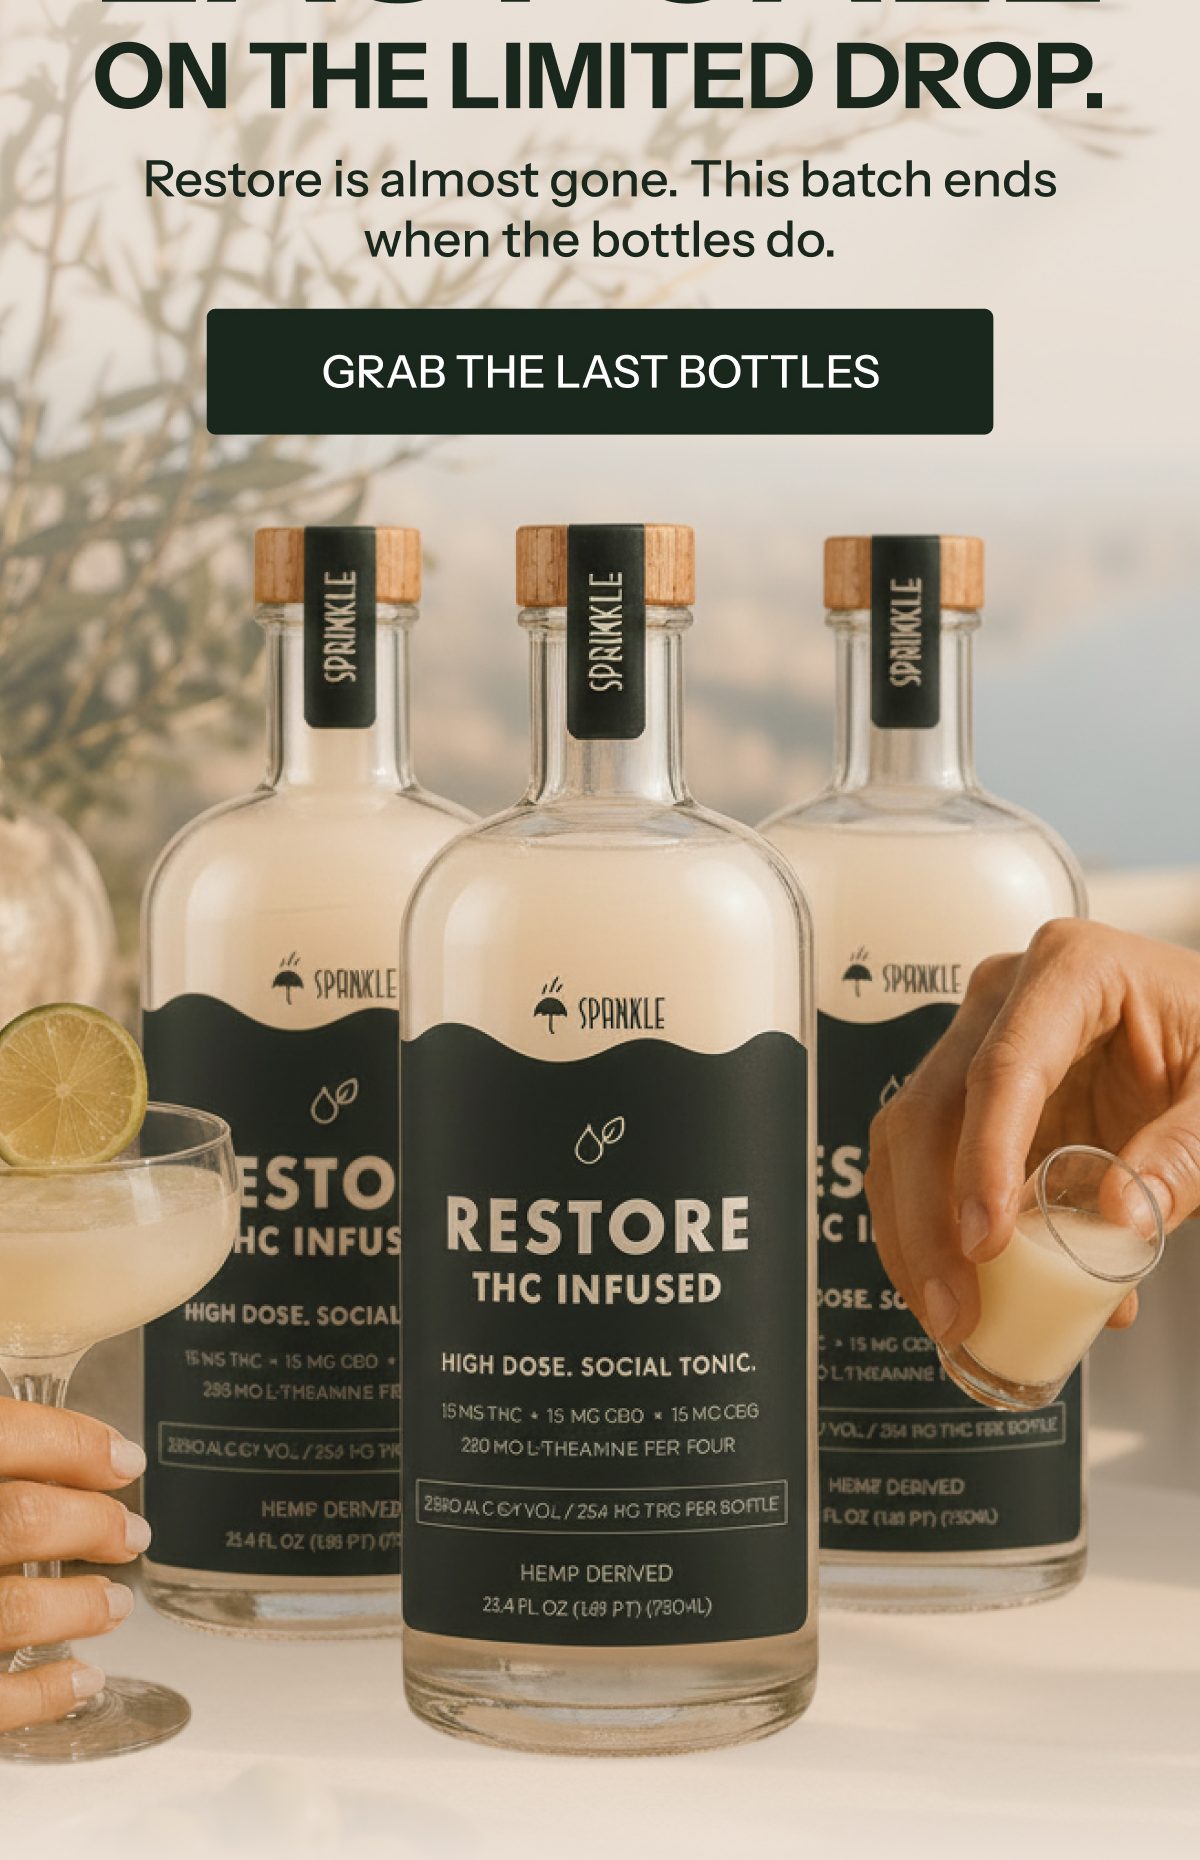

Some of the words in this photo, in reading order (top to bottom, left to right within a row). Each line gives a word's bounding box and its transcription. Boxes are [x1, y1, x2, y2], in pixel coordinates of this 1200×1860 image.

[578, 997, 665, 1029] SPANKLE
[447, 1195, 749, 1256] RESTORE
[472, 1271, 541, 1304] THC
[557, 1272, 722, 1304] INFUSED
[442, 1352, 494, 1375] HIGH
[502, 1356, 573, 1377] DOSE.
[581, 1356, 672, 1377] SOCIAL
[679, 1352, 756, 1376] TONIC.
[487, 1406, 523, 1423] THC
[571, 1408, 600, 1424] MG
[672, 1405, 689, 1422] 15
[687, 1437, 736, 1455] FOUR
[520, 1563, 580, 1583] HEMP
[543, 1599, 569, 1617] OZ
